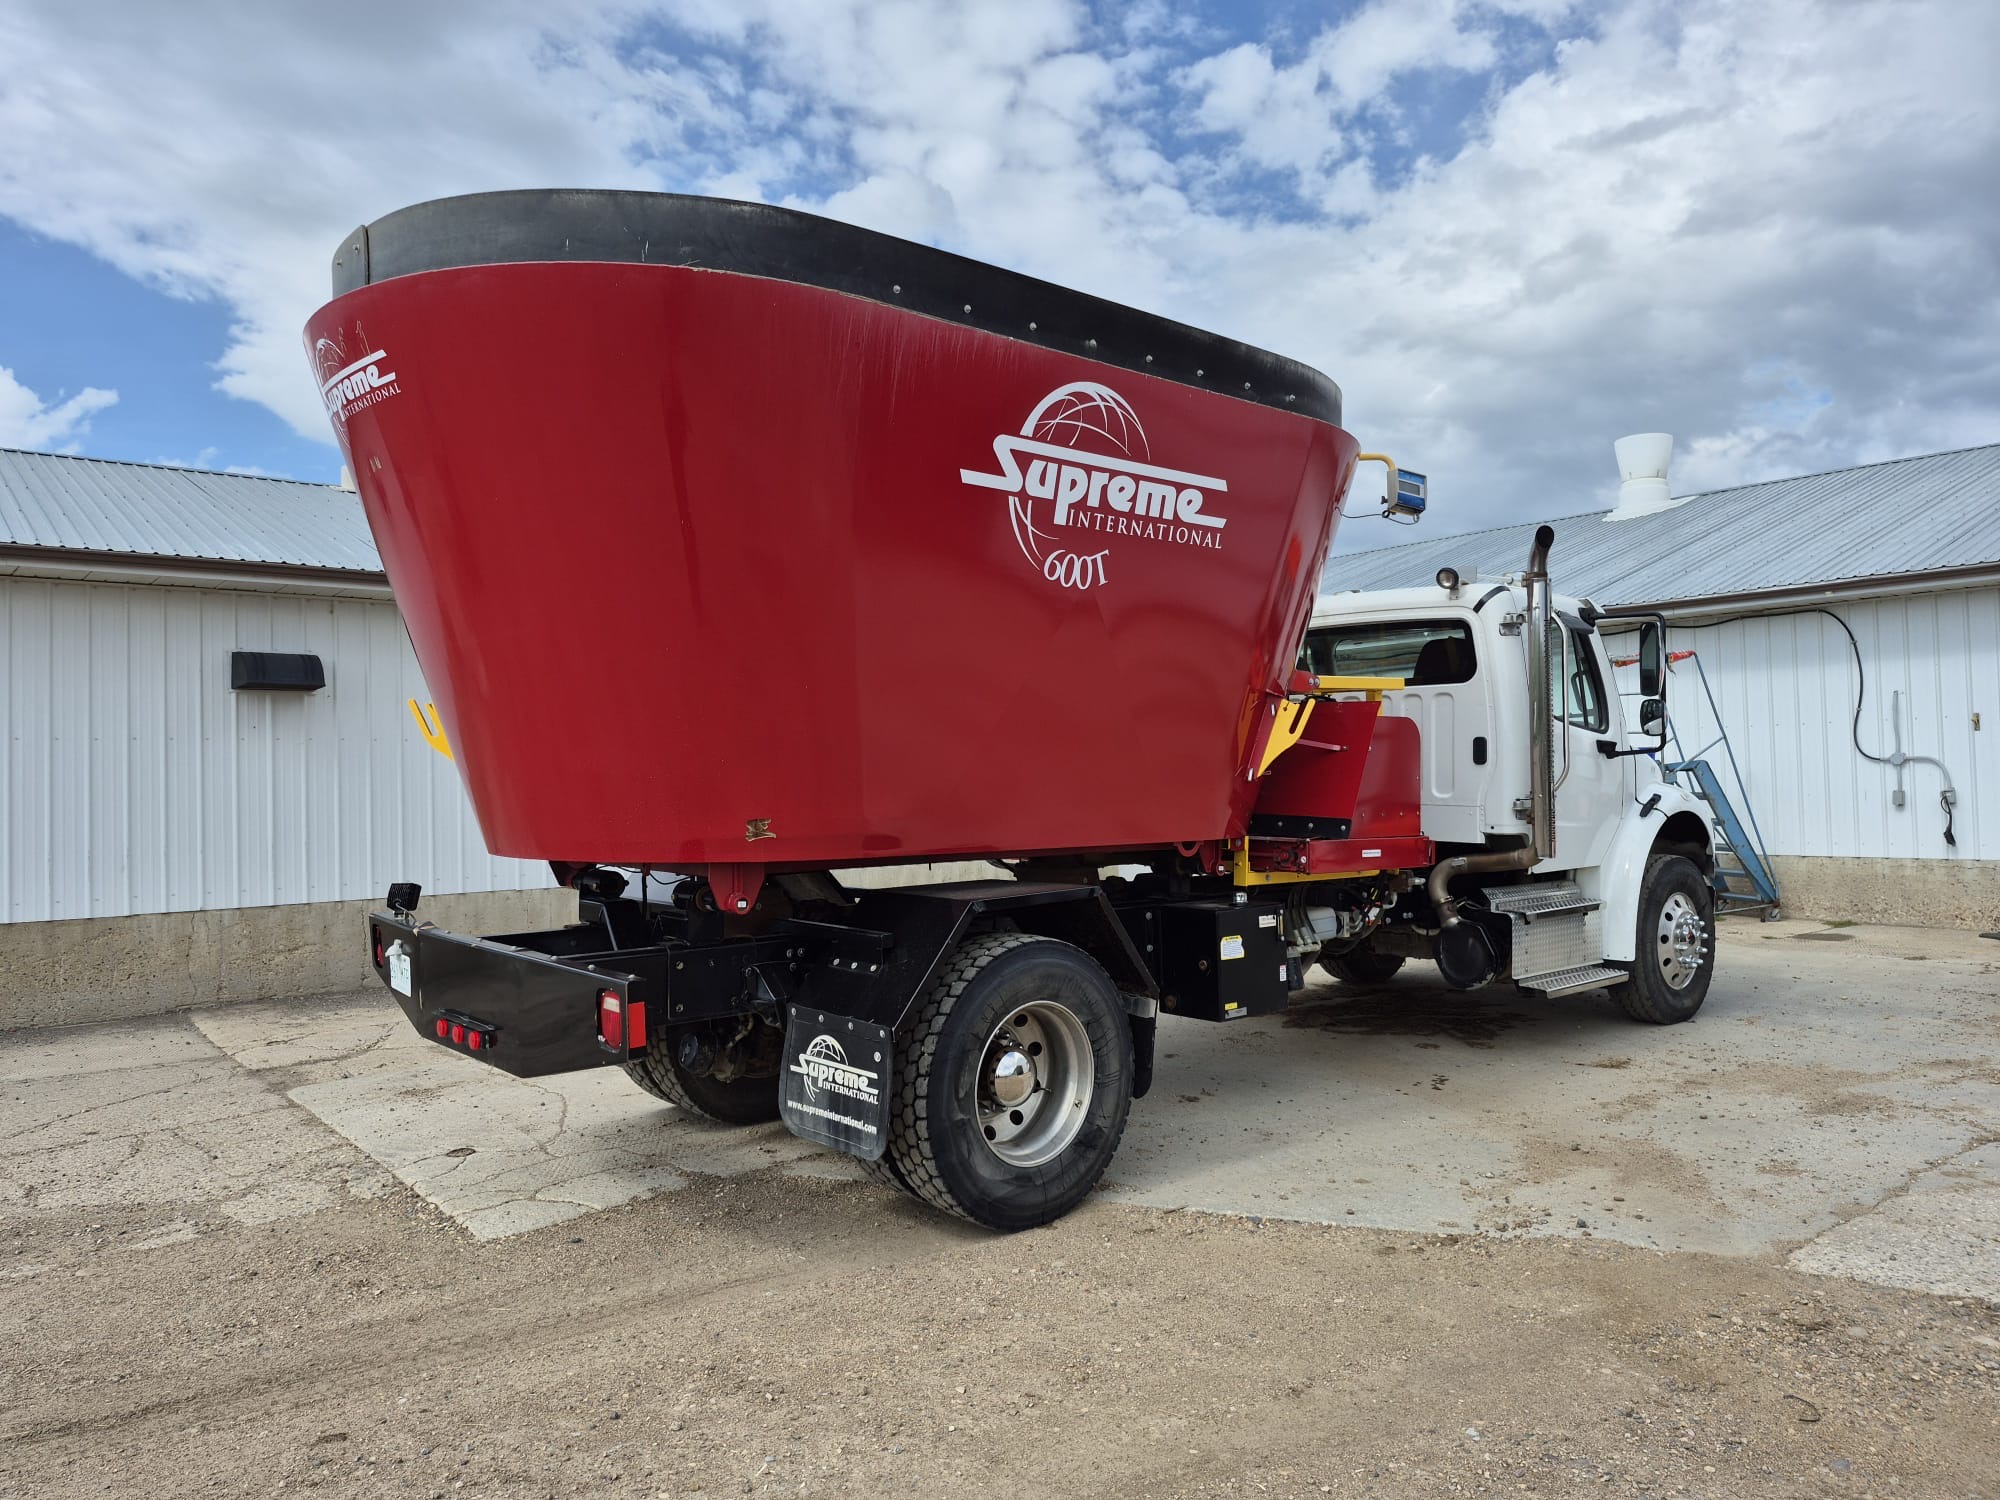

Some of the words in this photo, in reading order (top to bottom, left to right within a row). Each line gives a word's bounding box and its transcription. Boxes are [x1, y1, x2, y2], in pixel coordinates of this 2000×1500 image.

[344, 383, 401, 419] INTERNATIONAL
[960, 434, 1228, 529] Supreme
[1067, 508, 1223, 549] INTERNATIONAL
[1043, 549, 1109, 590] 600T
[790, 1053, 879, 1095] Supreme
[823, 1081, 879, 1105] INTERNATIONAL
[787, 1099, 877, 1135] www.supremeinternational.com
